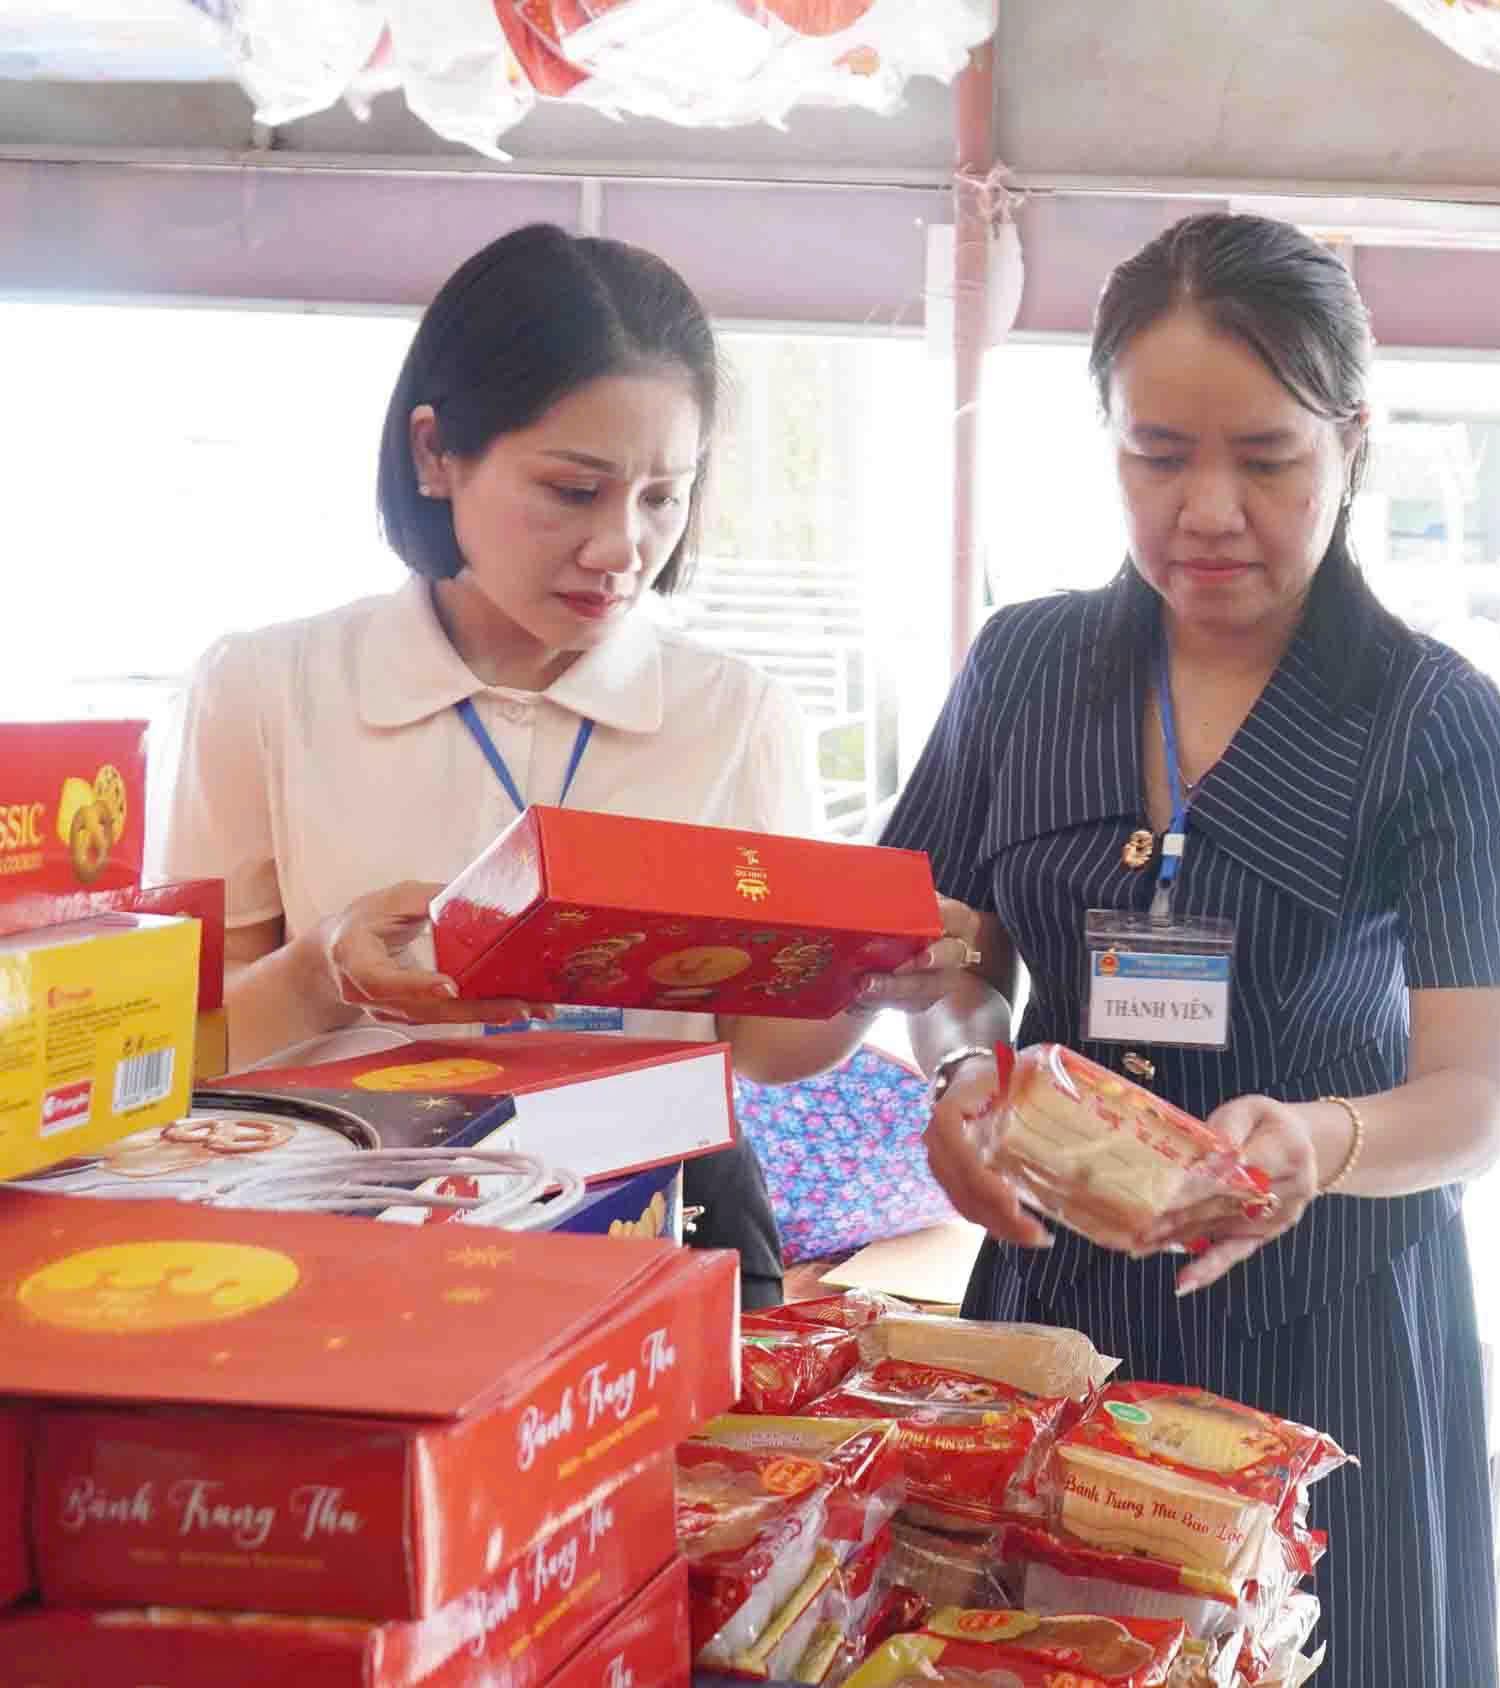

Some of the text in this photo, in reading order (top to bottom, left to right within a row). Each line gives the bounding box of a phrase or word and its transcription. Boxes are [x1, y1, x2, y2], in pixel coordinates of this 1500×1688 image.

[1165, 996, 1214, 1020] VIÊN
[578, 1361, 636, 1428] Trung
[640, 1328, 676, 1389] Thu
[167, 1480, 276, 1549] Trung
[289, 1484, 363, 1540] Thu
[1064, 1472, 1099, 1503] Bánh
[1105, 1487, 1144, 1520] Trung
